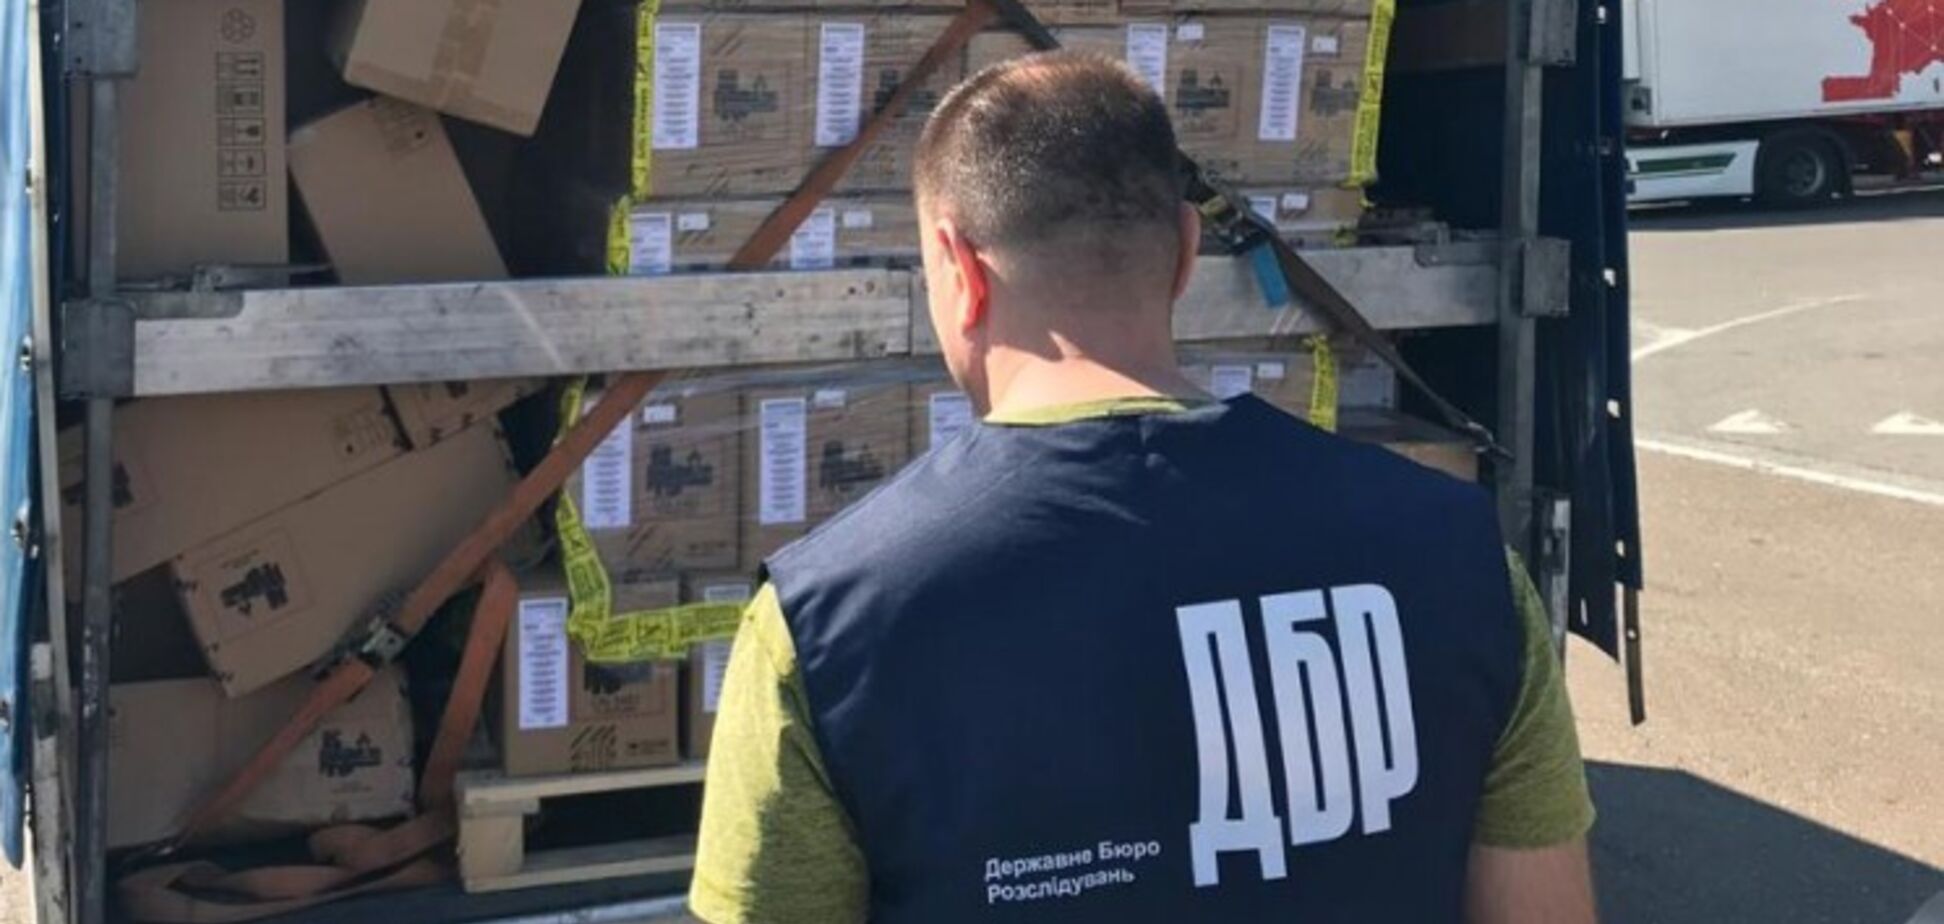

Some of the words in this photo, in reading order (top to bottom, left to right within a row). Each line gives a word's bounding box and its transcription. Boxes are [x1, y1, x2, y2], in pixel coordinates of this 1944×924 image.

[1175, 584, 1419, 887] ДБР
[985, 850, 1093, 882] Державне
[1098, 841, 1161, 860] Бюро
[988, 869, 1135, 904] Розслідувань
